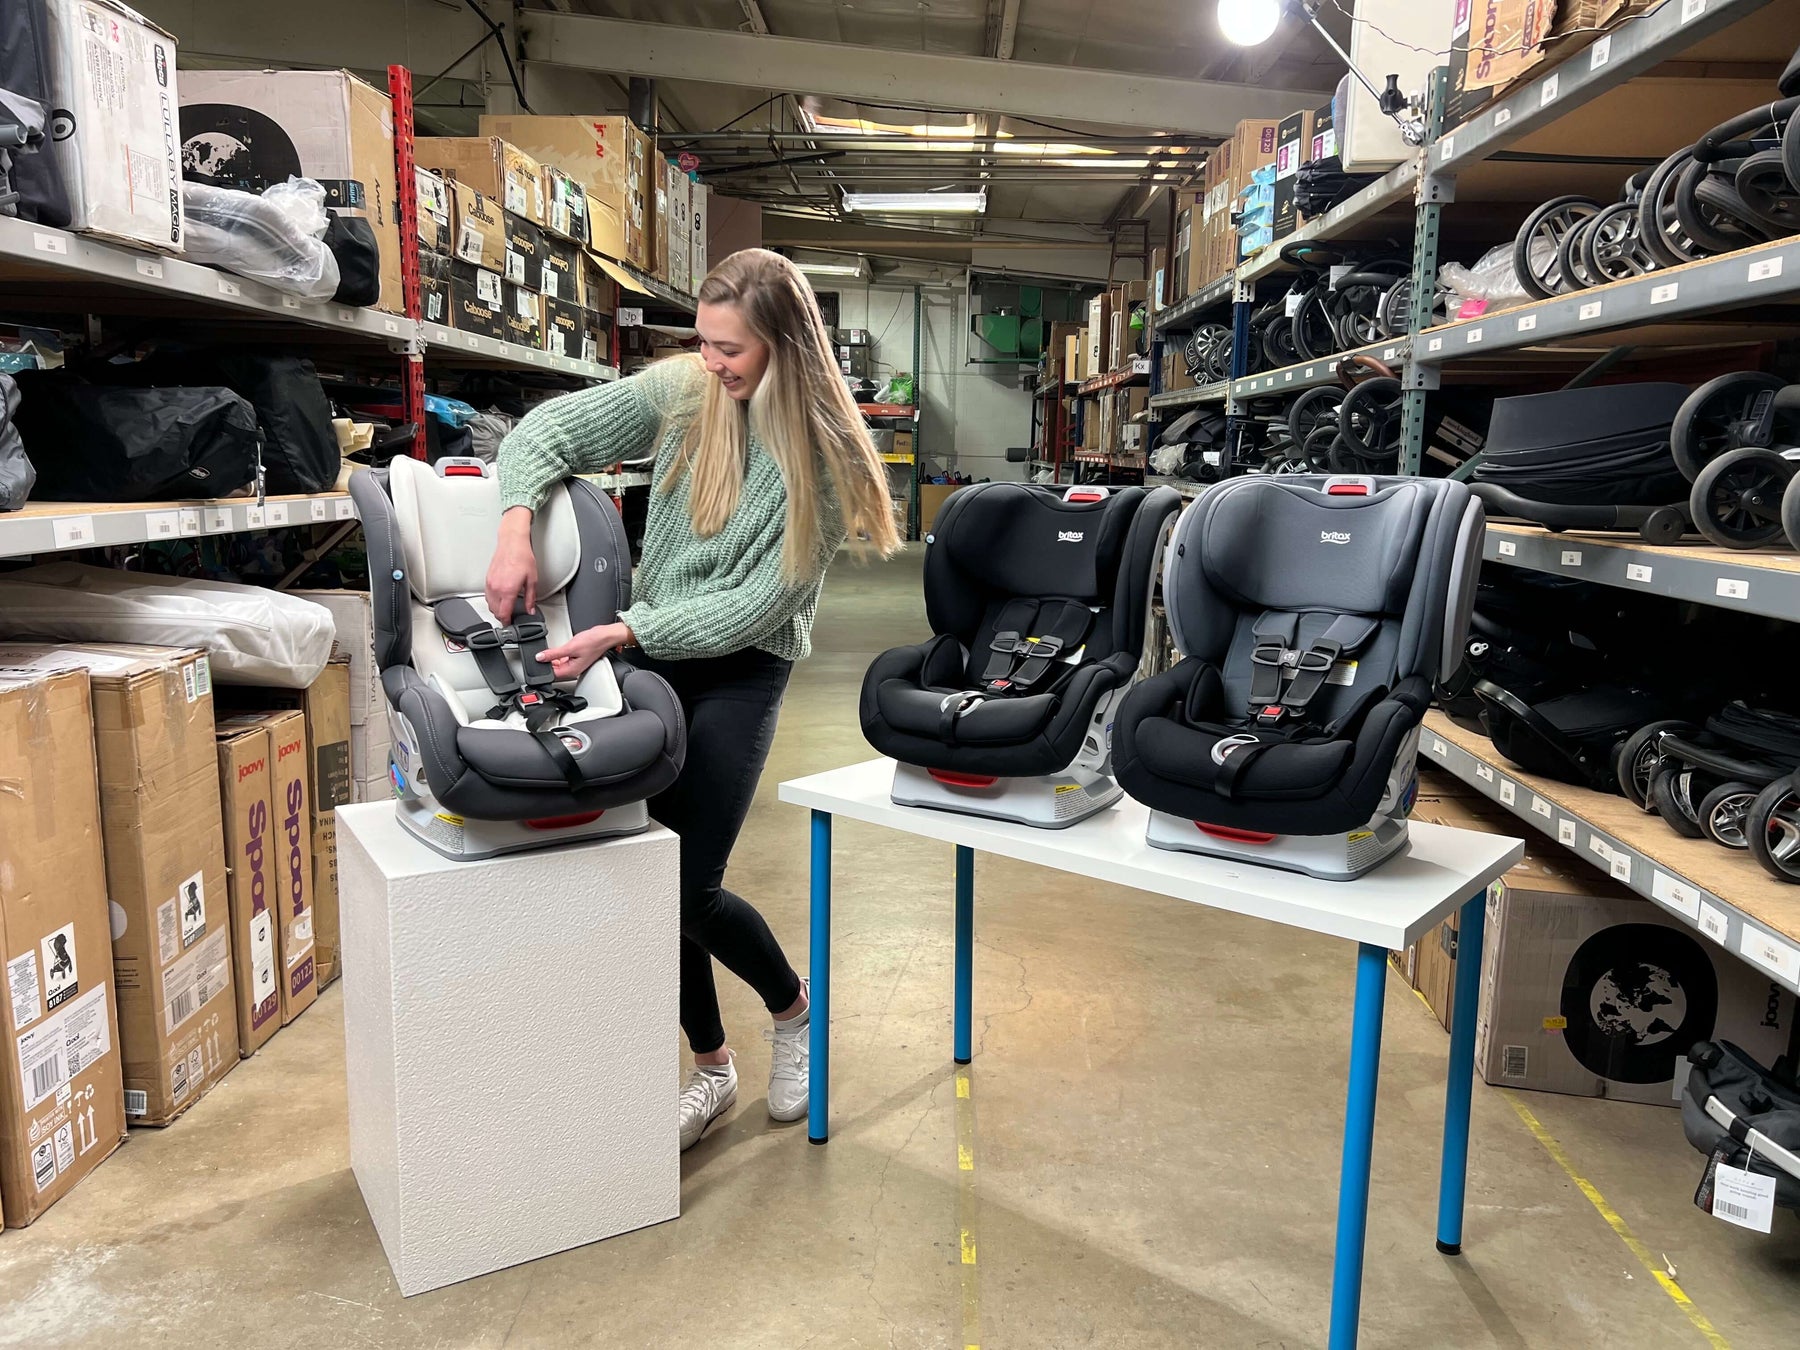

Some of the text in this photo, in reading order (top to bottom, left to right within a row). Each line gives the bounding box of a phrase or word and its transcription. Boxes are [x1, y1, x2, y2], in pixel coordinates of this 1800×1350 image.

[156, 46, 167, 87] chicco
[161, 95, 180, 243] LULLABY MAGIC
[348, 182, 357, 204] prime
[468, 202, 495, 226] Caboose
[464, 299, 493, 320] Caboose
[625, 312, 637, 323] Jp
[1135, 362, 1145, 370] Kx
[1058, 531, 1084, 540] britax
[1321, 530, 1351, 541] britax
[278, 739, 302, 763] joovy
[238, 758, 265, 783] joovy
[292, 961, 314, 990] 00122
[48, 992, 63, 1010] 8187
[252, 993, 278, 1022] 00129
[1760, 982, 1781, 1030] joov
[65, 1033, 80, 1048] Qool
